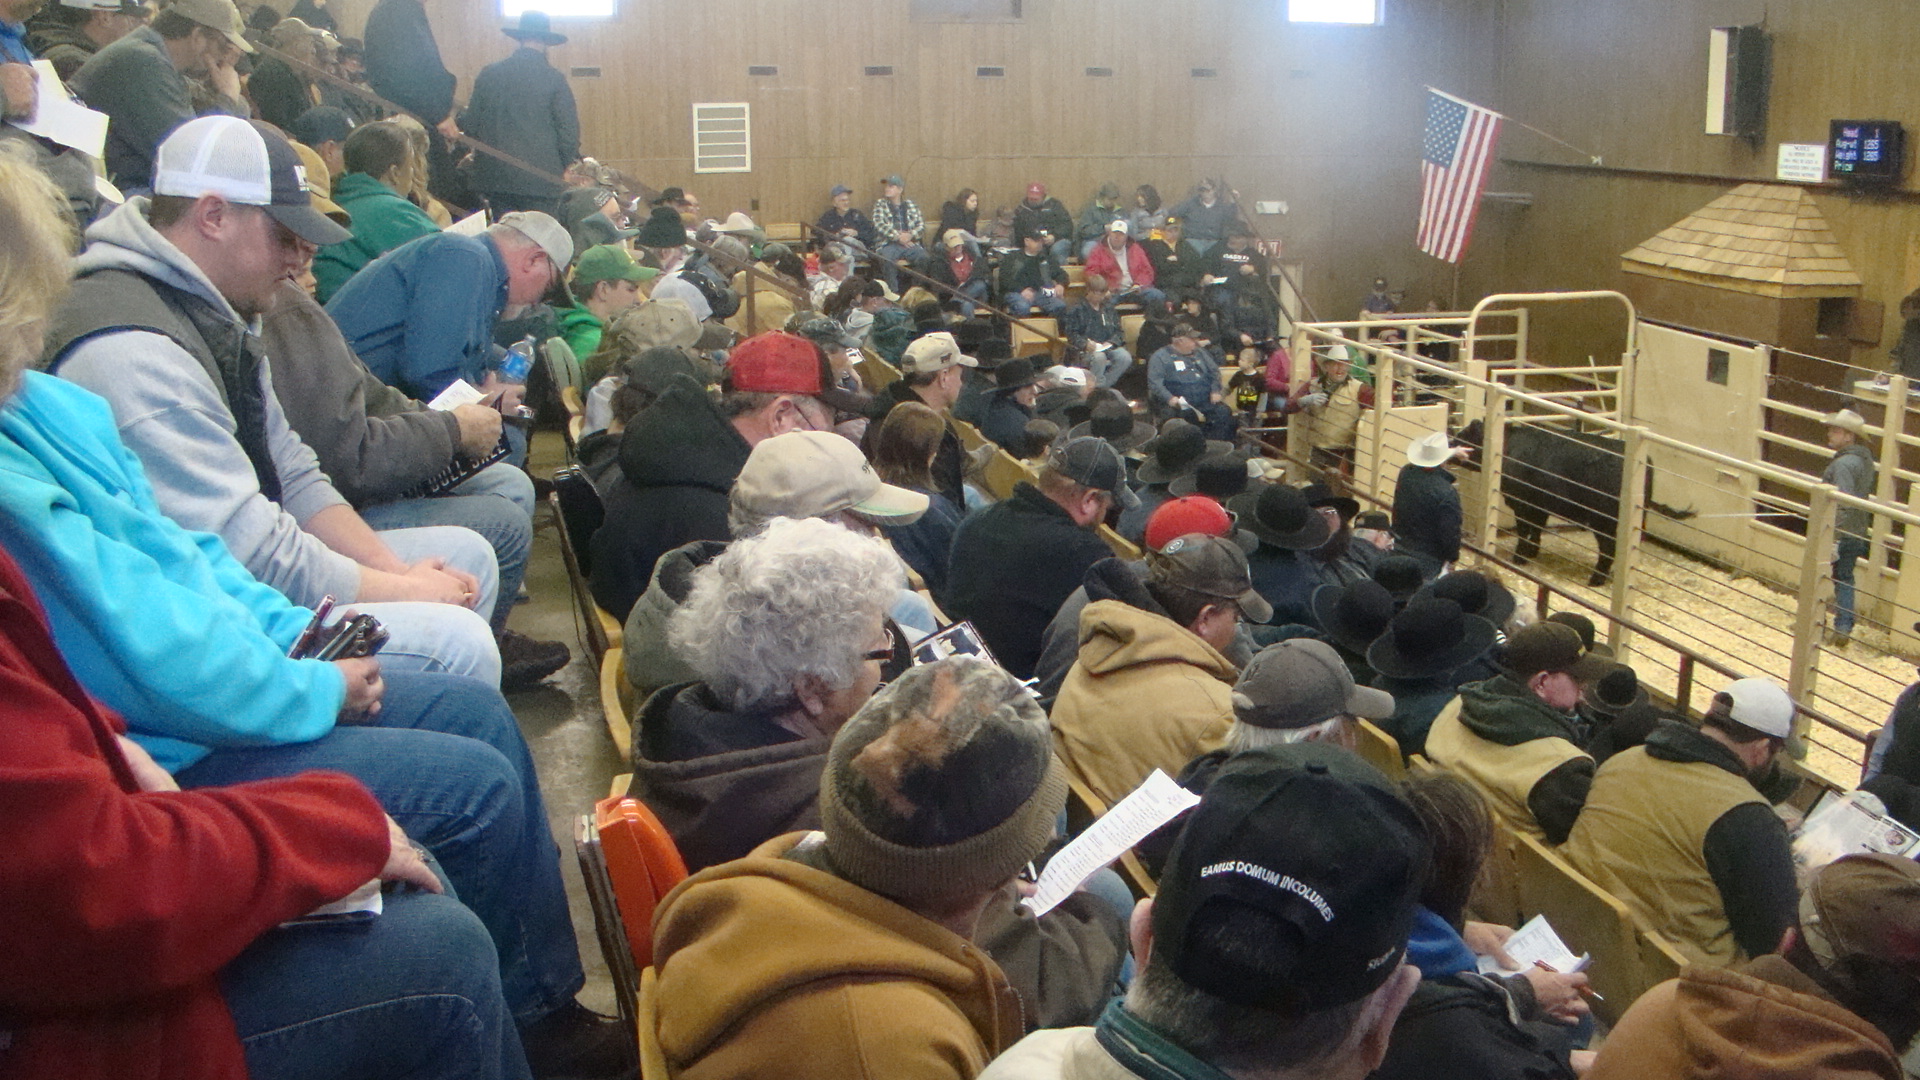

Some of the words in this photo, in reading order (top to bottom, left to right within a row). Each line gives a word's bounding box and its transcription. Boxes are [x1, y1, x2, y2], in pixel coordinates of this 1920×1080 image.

[1200, 860, 1236, 878] EAMUS
[1235, 860, 1280, 887] DOMUM
[1279, 874, 1335, 923] INCOLUMES
